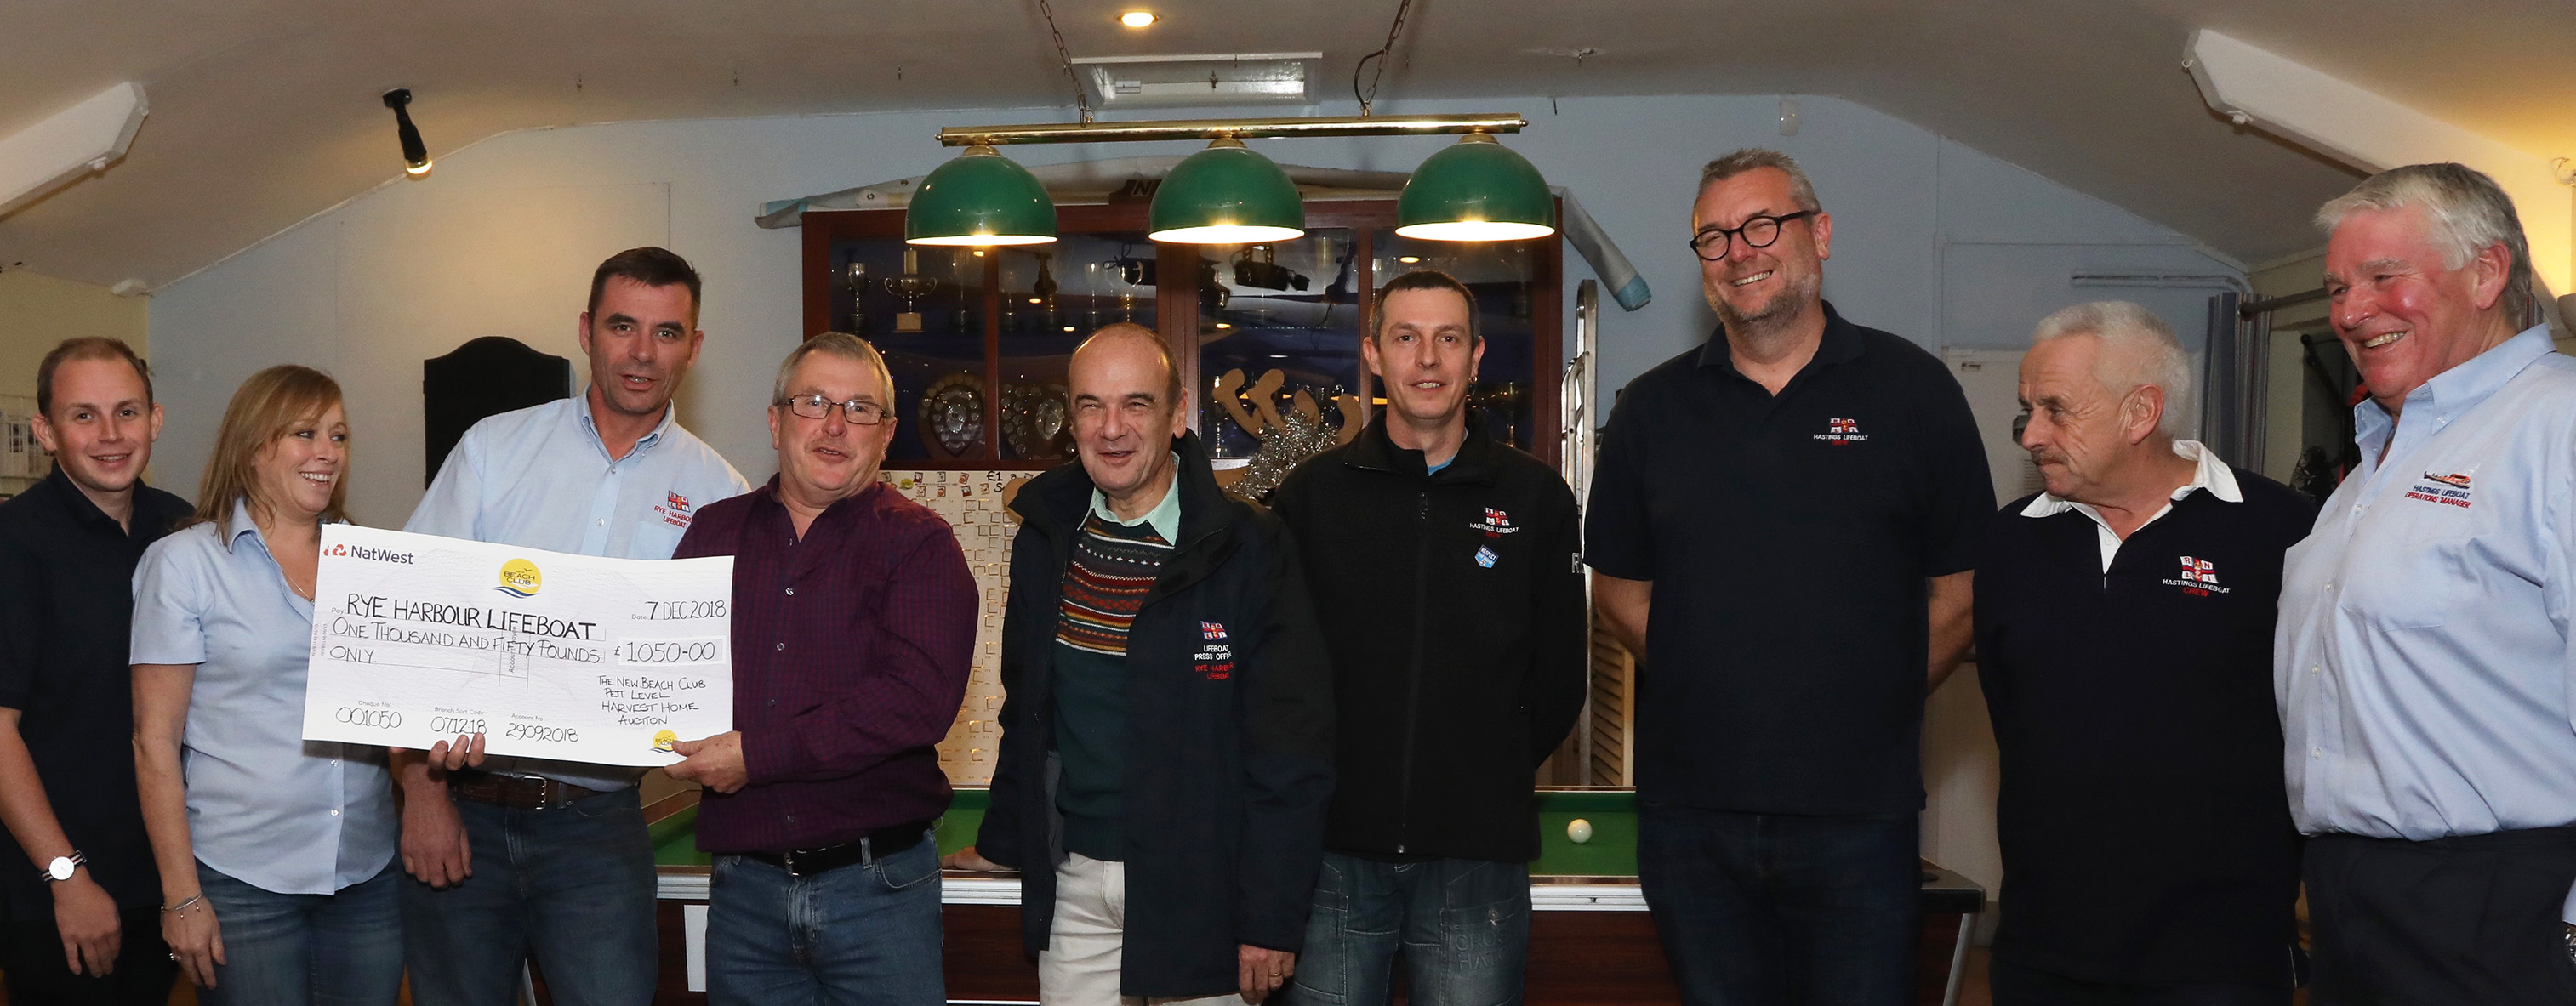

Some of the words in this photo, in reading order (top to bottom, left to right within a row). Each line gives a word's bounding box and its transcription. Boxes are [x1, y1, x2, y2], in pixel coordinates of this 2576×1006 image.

[1813, 433, 1842, 441] HASTINGS
[987, 470, 1003, 481] £1
[2404, 492, 2439, 503] OPERATIONS
[2413, 484, 2441, 496] HASTINGS
[2442, 489, 2471, 500] LIFEBOAT
[654, 505, 666, 514] RYE
[663, 515, 687, 528] LIFEBOAT
[1469, 522, 1495, 532] HASTINGS
[350, 544, 414, 565] NatWest
[504, 571, 535, 580] BEACH
[506, 577, 531, 585] CLUB
[2163, 578, 2197, 588] HASTINGS
[2198, 583, 2231, 594] LIFEBOAT
[2182, 587, 2209, 597] CREW
[347, 593, 388, 618] RYE
[394, 599, 482, 629] HARBOUR
[487, 609, 596, 640] LIFEBOAT
[645, 601, 658, 620] 7
[663, 601, 687, 621] DEC
[691, 600, 727, 619] 2018
[333, 617, 369, 639] ONE
[371, 621, 454, 647] THOUSAND
[459, 634, 489, 650] AND
[493, 636, 535, 659] FIFTY
[538, 639, 601, 664] POUNDS
[626, 641, 715, 663] 1050-00
[597, 675, 614, 686] THE
[617, 676, 638, 687] NEW
[641, 676, 674, 691] BEACH
[678, 677, 706, 690] CLUB
[604, 687, 626, 698] PETT
[630, 690, 670, 700] LEVEL
[601, 701, 658, 713] HARVEST
[661, 702, 699, 713] HOME
[335, 706, 402, 730] 001050
[618, 714, 668, 725] AUCTION
[505, 722, 579, 742] 29092018
